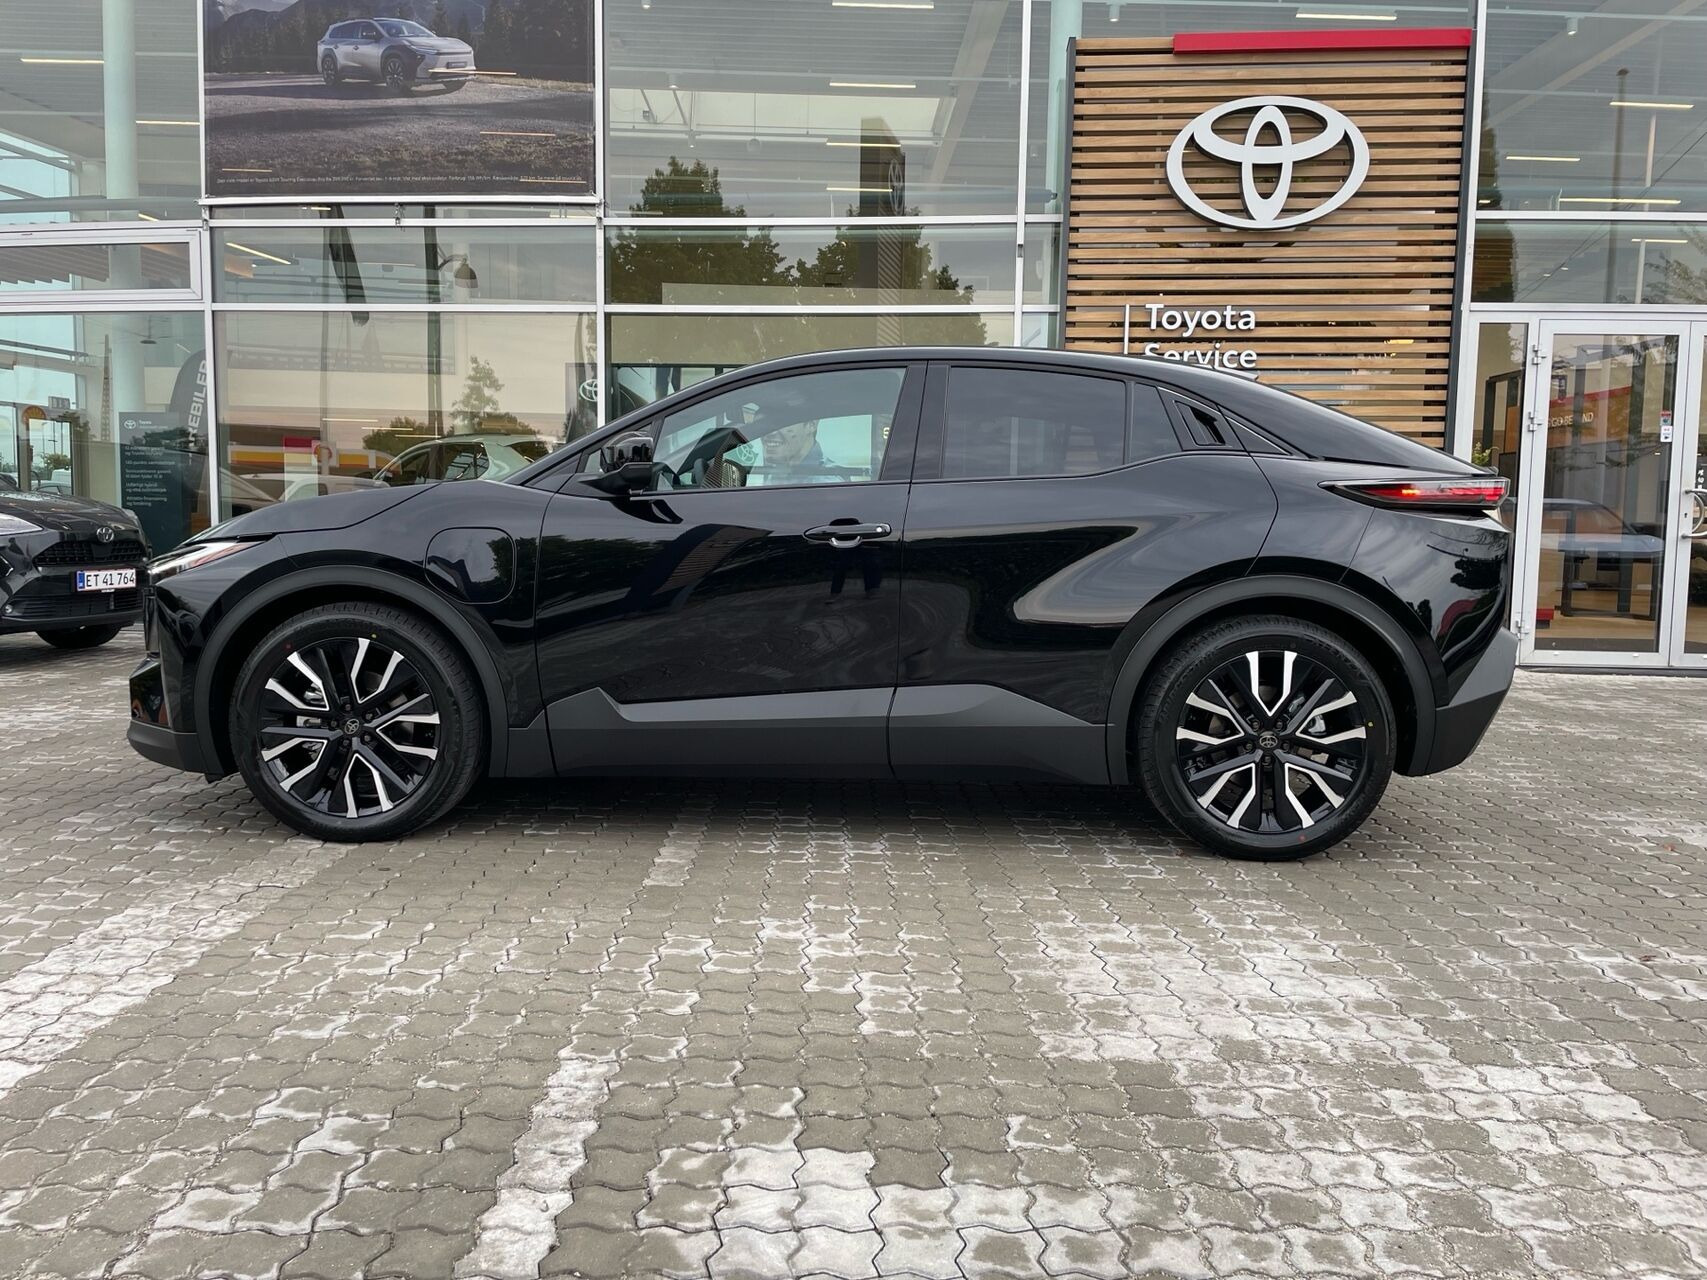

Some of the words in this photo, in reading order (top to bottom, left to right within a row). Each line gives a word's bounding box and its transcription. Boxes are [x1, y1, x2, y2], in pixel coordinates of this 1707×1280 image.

[1145, 303, 1256, 338] Toyota
[86, 574, 99, 588] ET
[102, 573, 114, 586] 41
[116, 572, 135, 586] 764
